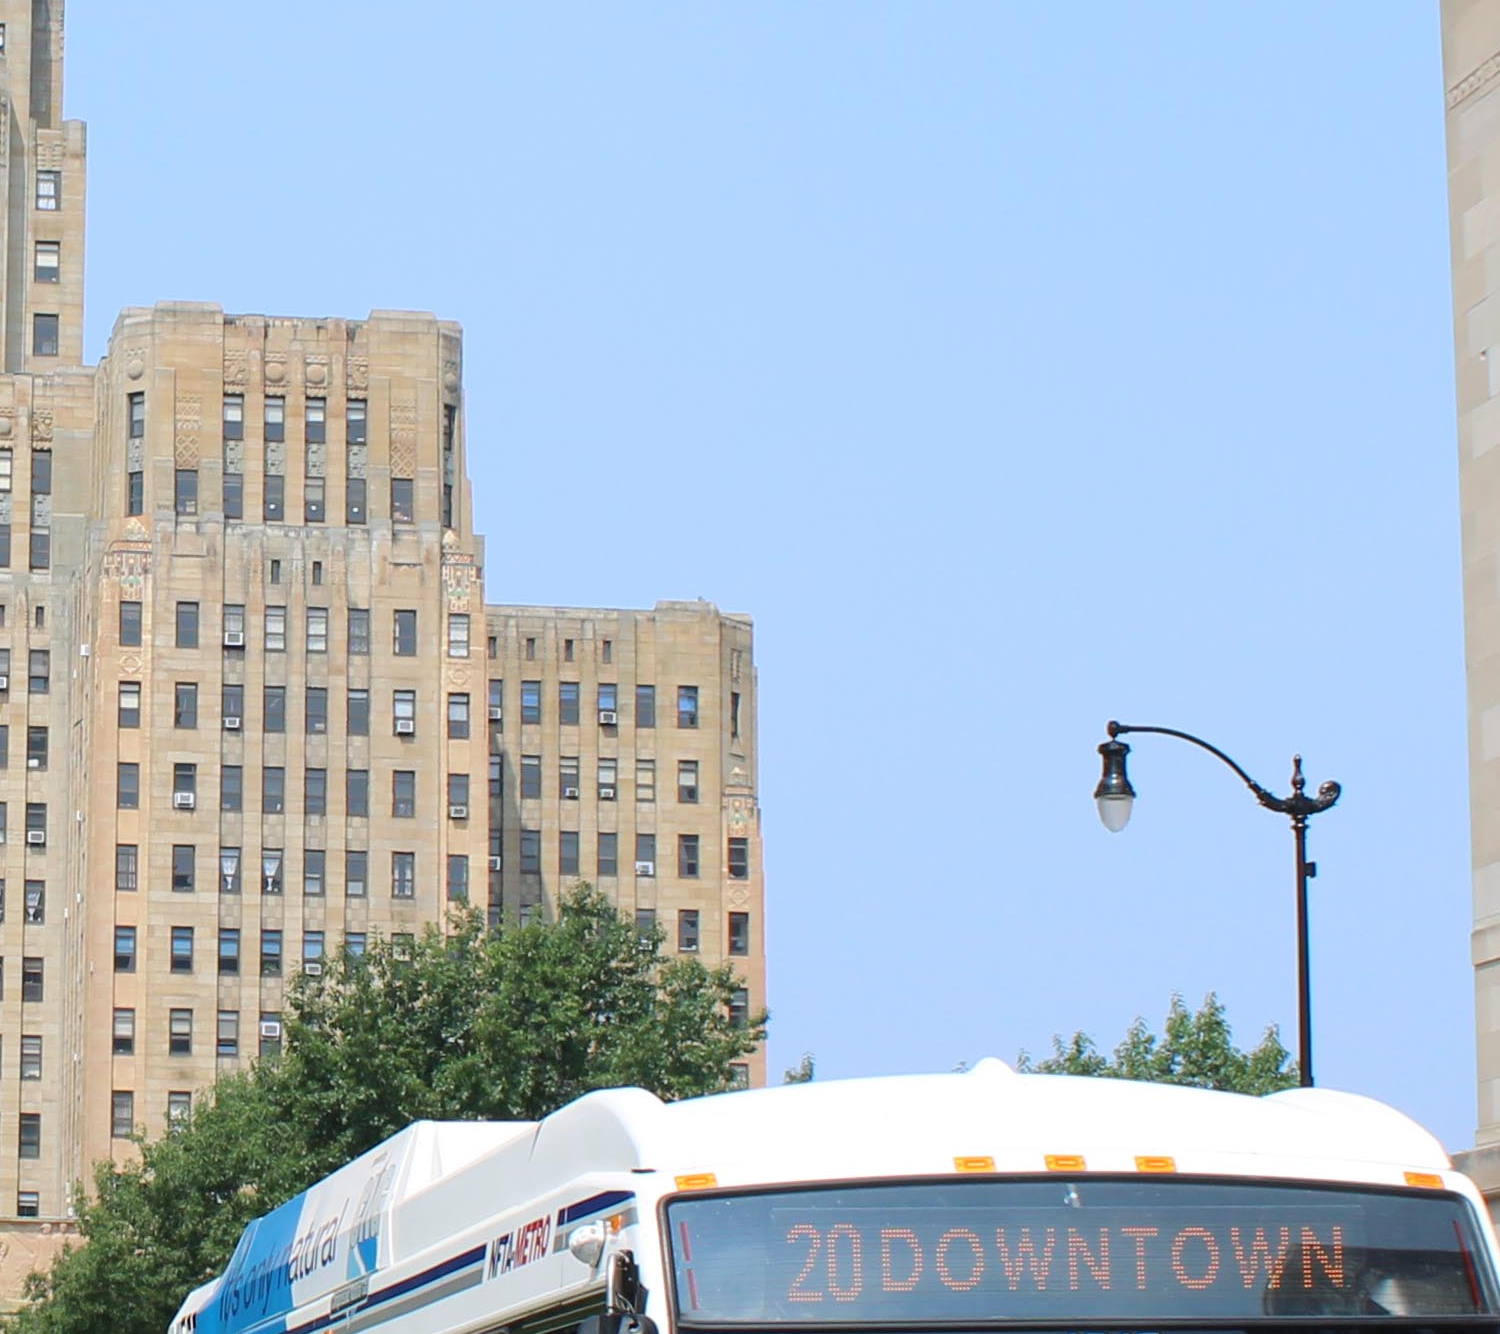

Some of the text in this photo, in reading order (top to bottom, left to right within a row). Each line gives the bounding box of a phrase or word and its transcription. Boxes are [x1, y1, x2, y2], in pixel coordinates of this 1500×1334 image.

[277, 1196, 349, 1290] natural
[487, 1214, 551, 1281] NFTA-METRO
[786, 1223, 1347, 1303] 20 DOWNTOWN
